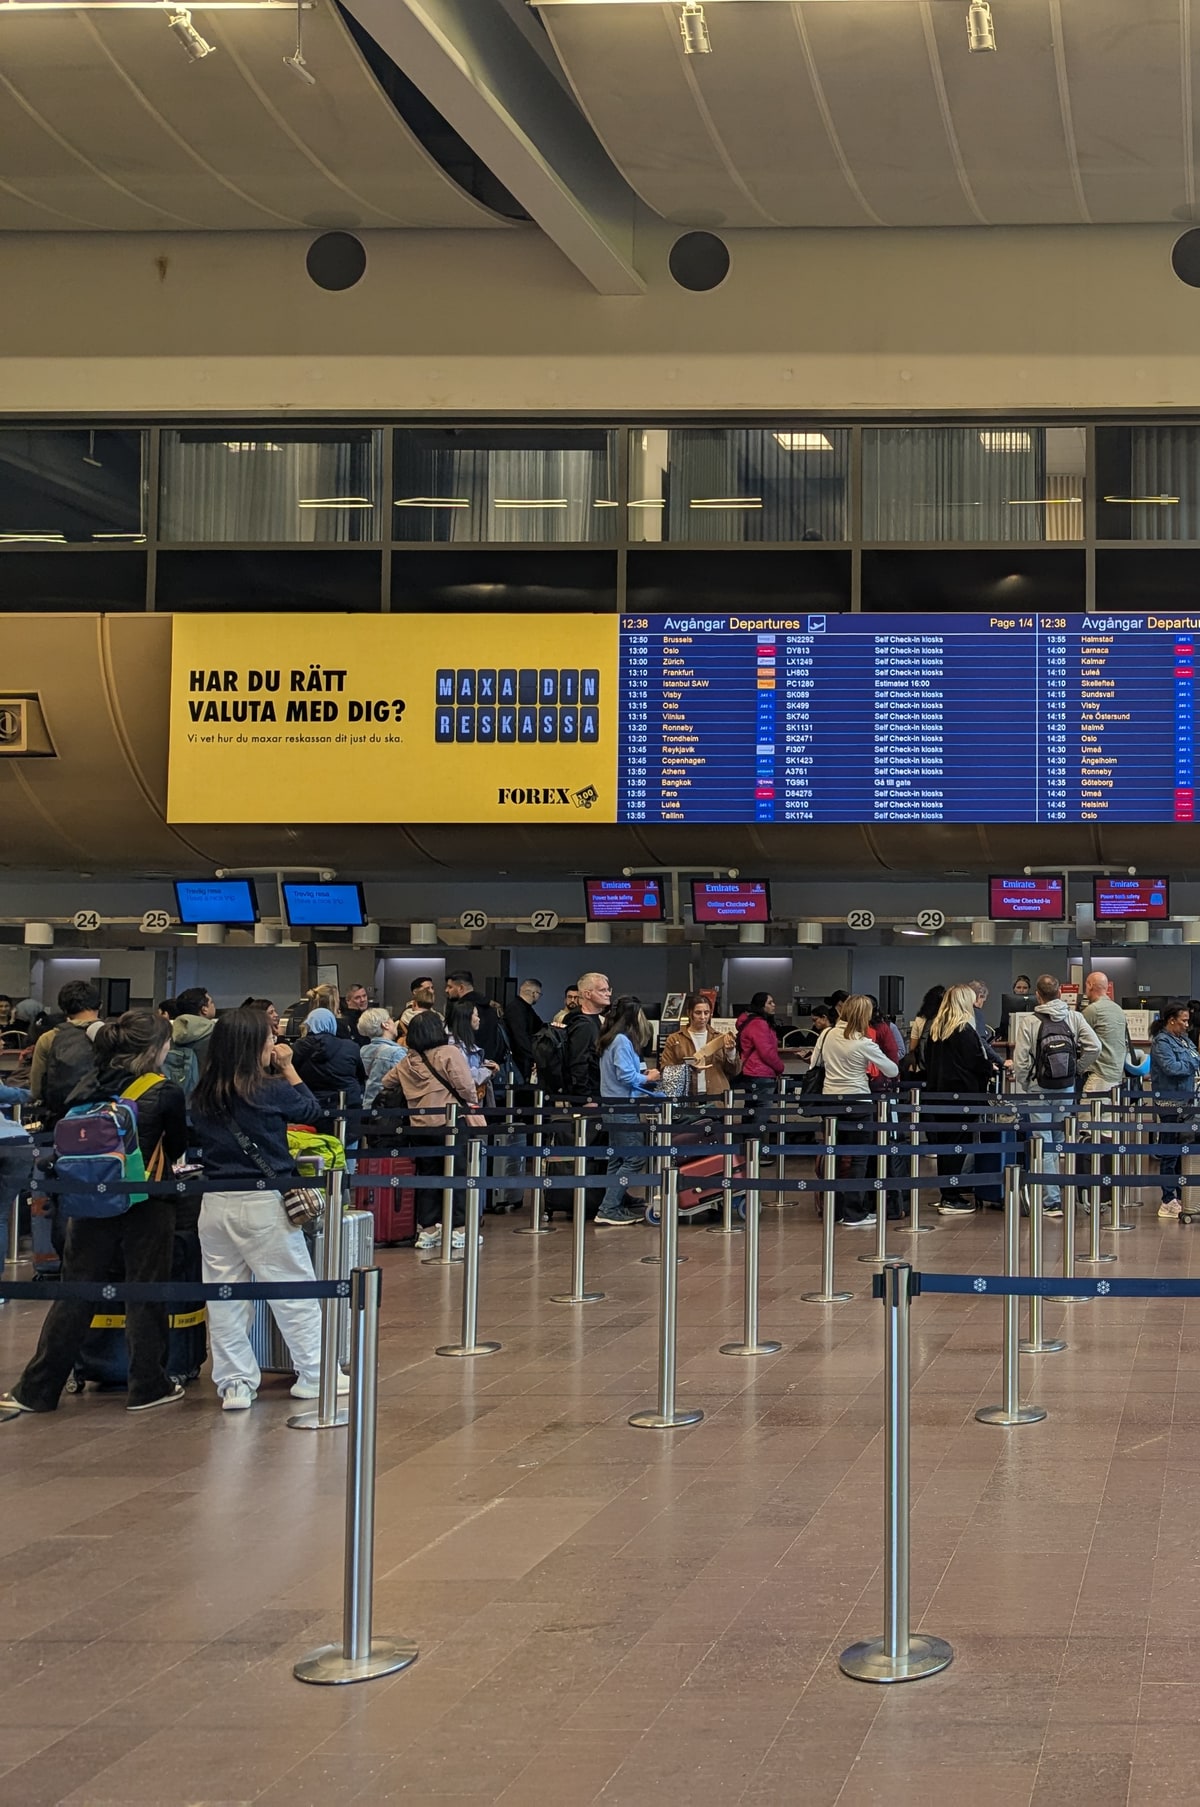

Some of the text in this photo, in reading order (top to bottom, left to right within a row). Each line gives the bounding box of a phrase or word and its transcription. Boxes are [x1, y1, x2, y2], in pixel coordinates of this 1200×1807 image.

[622, 617, 1033, 632] 12:38 Avgångar Departures Page 1/4
[1040, 618, 1067, 628] 12:38
[1082, 617, 1143, 631] Avgångar
[628, 636, 648, 644] 12:50
[663, 636, 693, 644] Brussels
[189, 664, 347, 692] HAR DU RÄTT
[628, 680, 648, 688] 13:10
[663, 680, 690, 688] Istanbul
[691, 680, 709, 688] SAW
[439, 678, 596, 696] MAXA DIN
[188, 700, 406, 723] VALUTA MED DIG?
[440, 716, 595, 735] RESKASSA
[628, 724, 647, 732] 13:20
[662, 724, 694, 733] Ronneby
[187, 734, 198, 743] Vi
[200, 734, 215, 743] vet
[217, 734, 233, 743] hur
[236, 734, 248, 743] du
[285, 734, 332, 743] reskassan
[335, 734, 347, 743] dit
[350, 734, 366, 745] just
[369, 734, 381, 743] du
[384, 734, 403, 743] ska.
[498, 788, 570, 804] FOREX
[601, 881, 632, 889] Emirates
[705, 884, 740, 892] Emirates
[1110, 880, 1139, 888] Emirates
[77, 913, 98, 928] 24
[146, 912, 167, 927] 25
[463, 912, 485, 927] 26
[534, 912, 555, 927] 27
[850, 912, 872, 927] 28
[921, 912, 943, 927] 29
